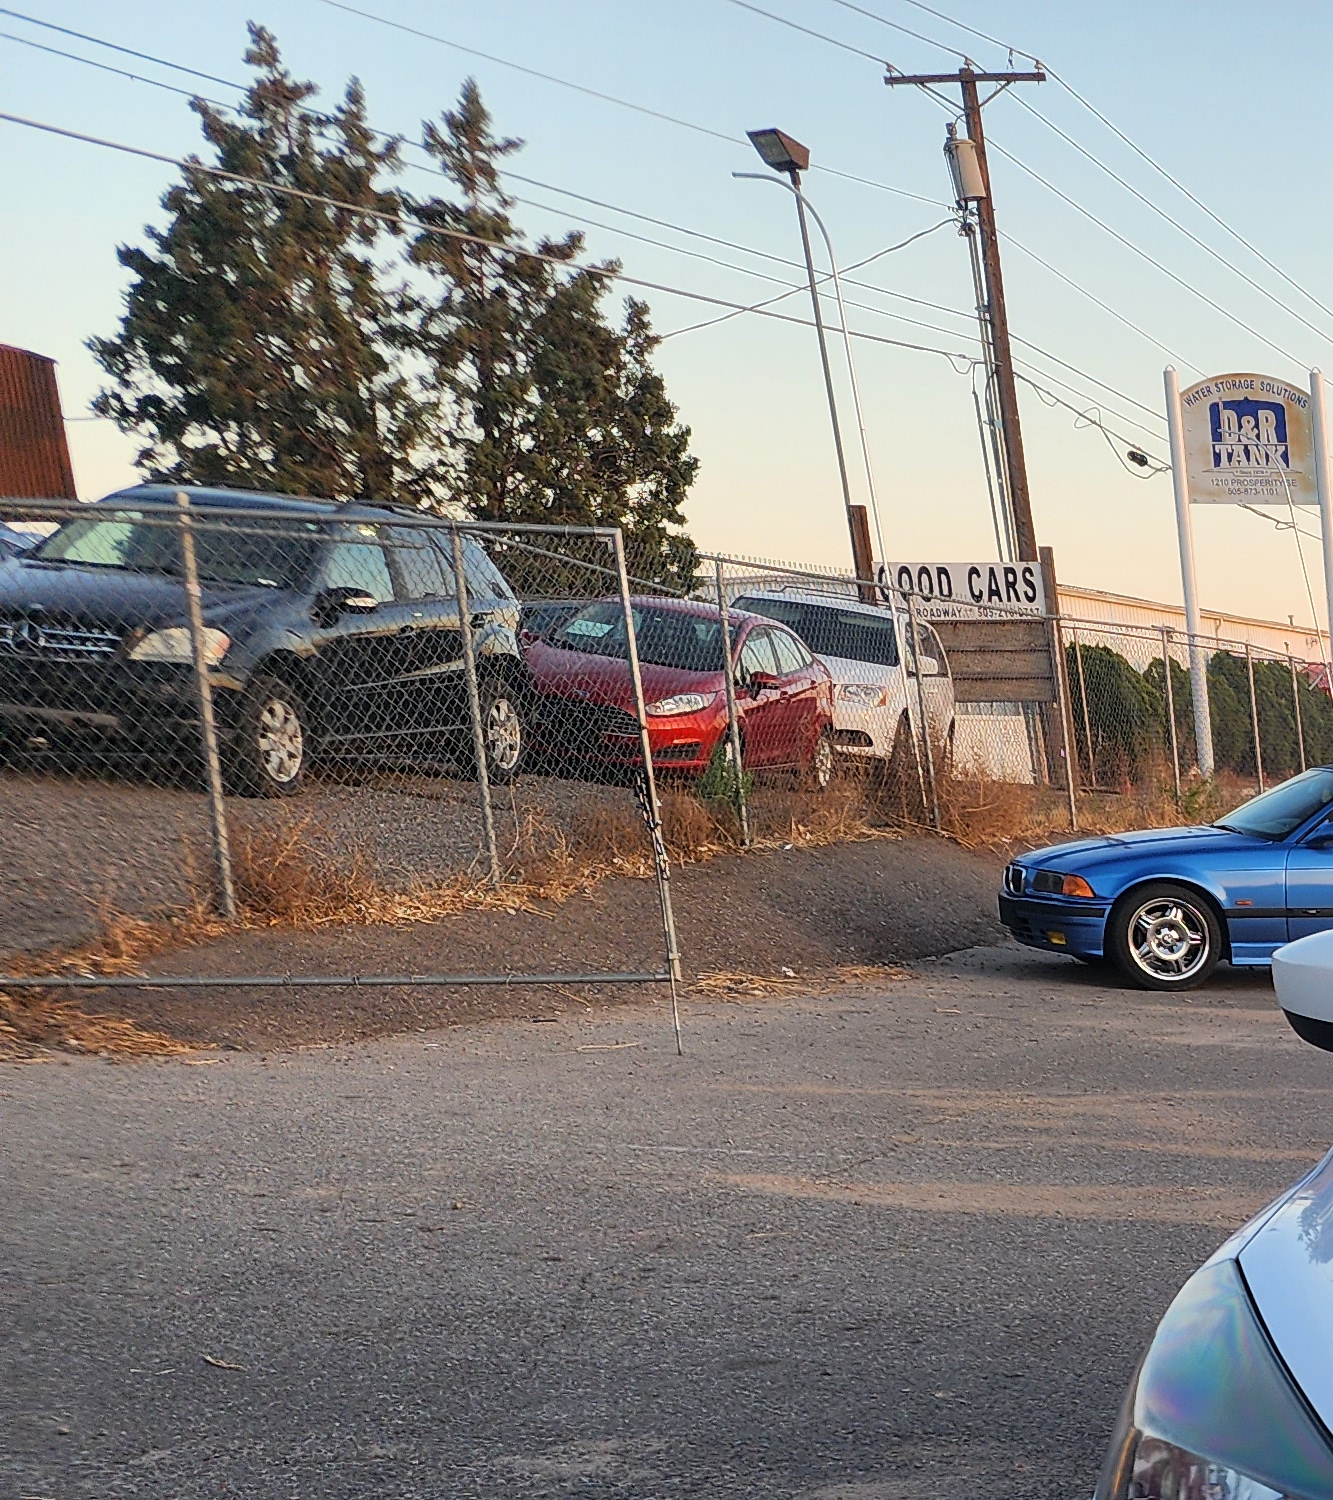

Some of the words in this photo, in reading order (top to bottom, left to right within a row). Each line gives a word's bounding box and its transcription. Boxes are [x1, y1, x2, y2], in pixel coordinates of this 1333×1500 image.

[1184, 385, 1214, 408] WATER
[1215, 379, 1255, 393] STORAGE
[1260, 381, 1308, 409] SOLUTIONS
[1222, 409, 1278, 443] D&R
[1215, 445, 1289, 468] TANK
[1211, 479, 1229, 487] 1210
[1231, 479, 1283, 487] PROSPERITY
[1228, 487, 1279, 496] 505-873-1101
[967, 566, 1037, 603] CARS
[914, 606, 962, 619] ROADWAY
